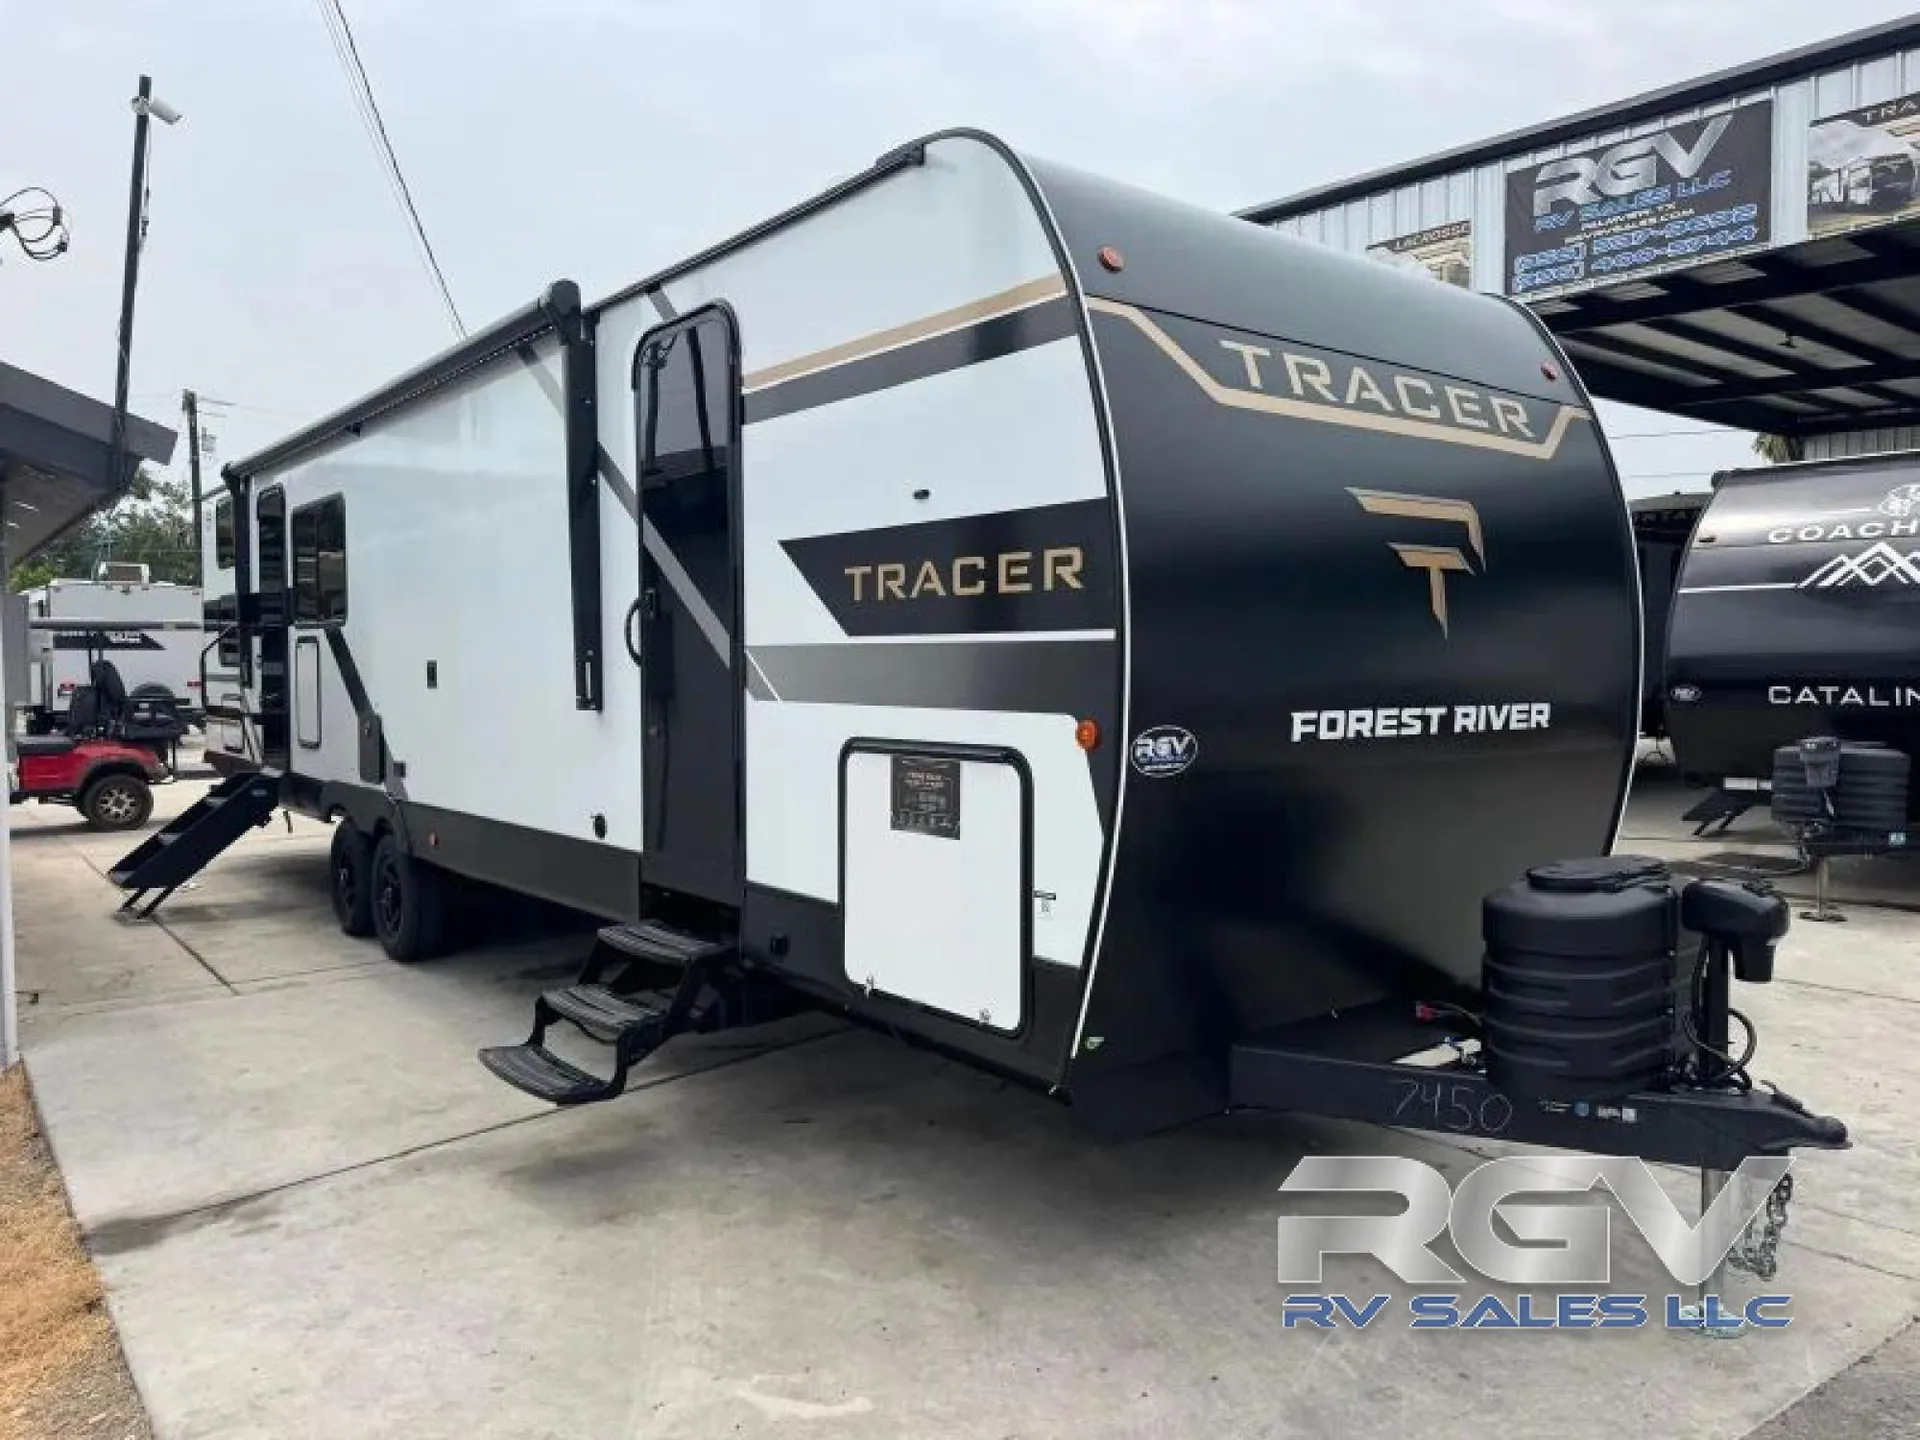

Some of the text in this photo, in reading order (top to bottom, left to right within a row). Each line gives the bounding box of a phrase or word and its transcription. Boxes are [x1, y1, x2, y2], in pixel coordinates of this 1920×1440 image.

[1533, 114, 1734, 217] RGV
[1535, 209, 1575, 234] RV
[1579, 184, 1671, 221] SALES
[1677, 169, 1733, 198] LLC
[1220, 340, 1536, 438] TRACER
[1768, 518, 1919, 543] COACH
[845, 546, 1085, 601] TRACER
[1290, 702, 1551, 742] FOREST RIVER
[1389, 1079, 1513, 1131] 7450
